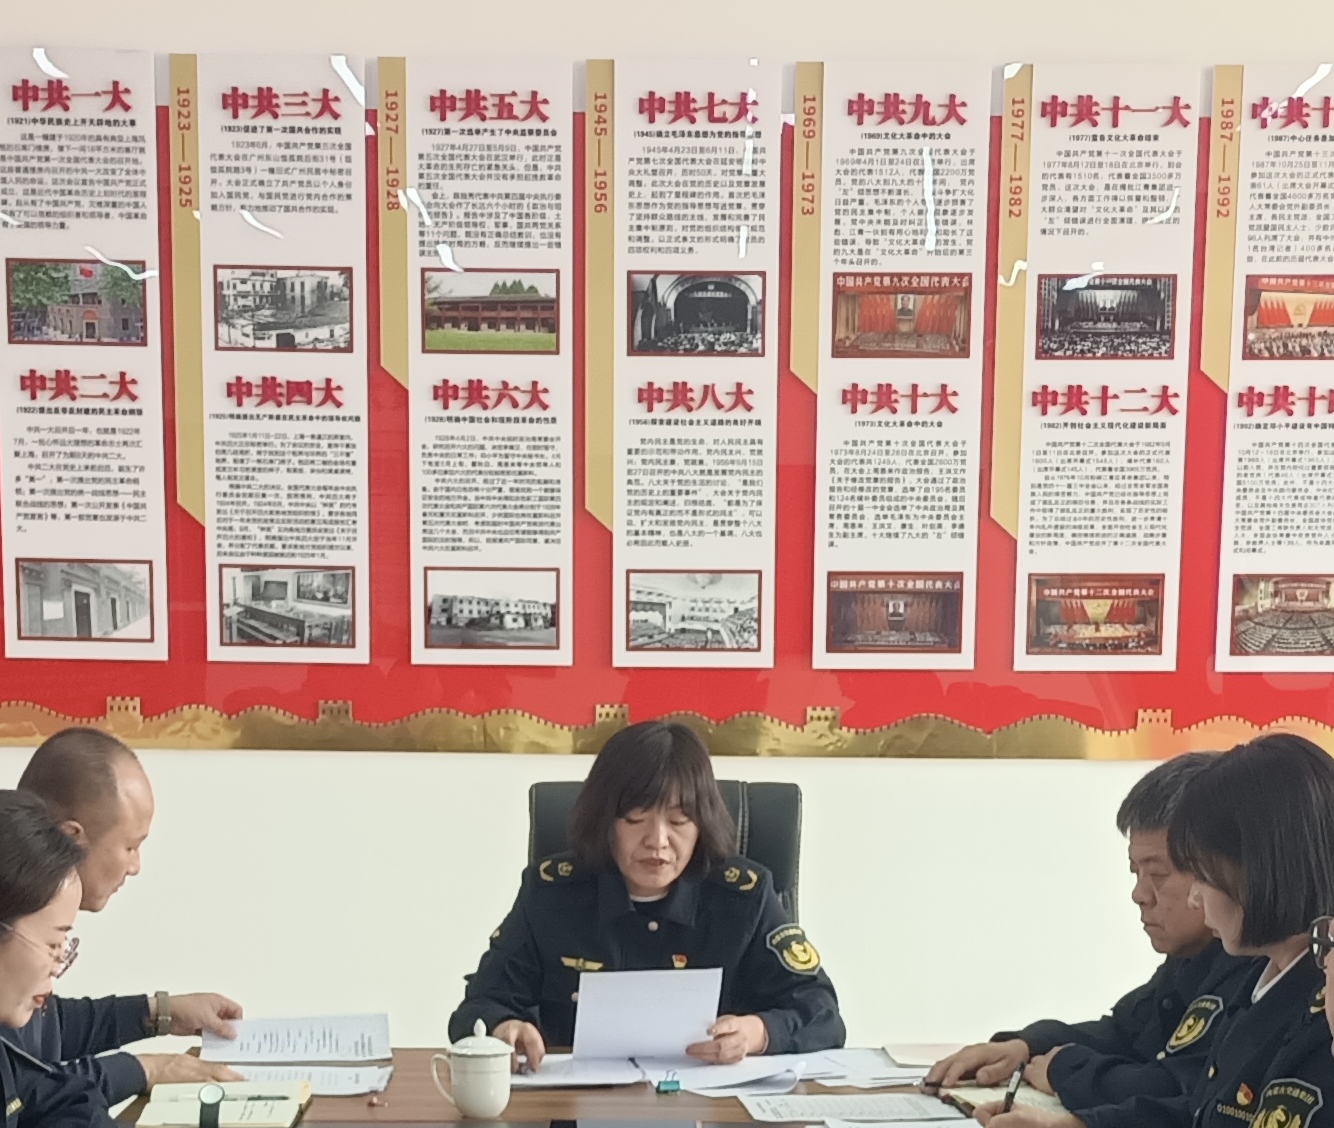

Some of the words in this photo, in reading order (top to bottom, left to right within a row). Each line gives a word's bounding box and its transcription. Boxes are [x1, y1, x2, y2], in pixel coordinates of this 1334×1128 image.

[12, 79, 132, 112] 中共一大
[222, 86, 341, 120] 中共三大
[430, 89, 549, 122] 中共五大
[638, 91, 758, 124] 中共七大
[847, 93, 967, 126] 中共九大
[1040, 95, 1191, 128] 中共十一大
[634, 130, 762, 139] (1945)确立毛泽东思想为党的指导想
[20, 369, 138, 401] 中共二大
[227, 376, 343, 408] 中共四大
[433, 379, 549, 410] 中共六大
[638, 381, 754, 413] 中共八大
[841, 383, 958, 414] 中共十大
[1031, 385, 1180, 416] 中共十二大
